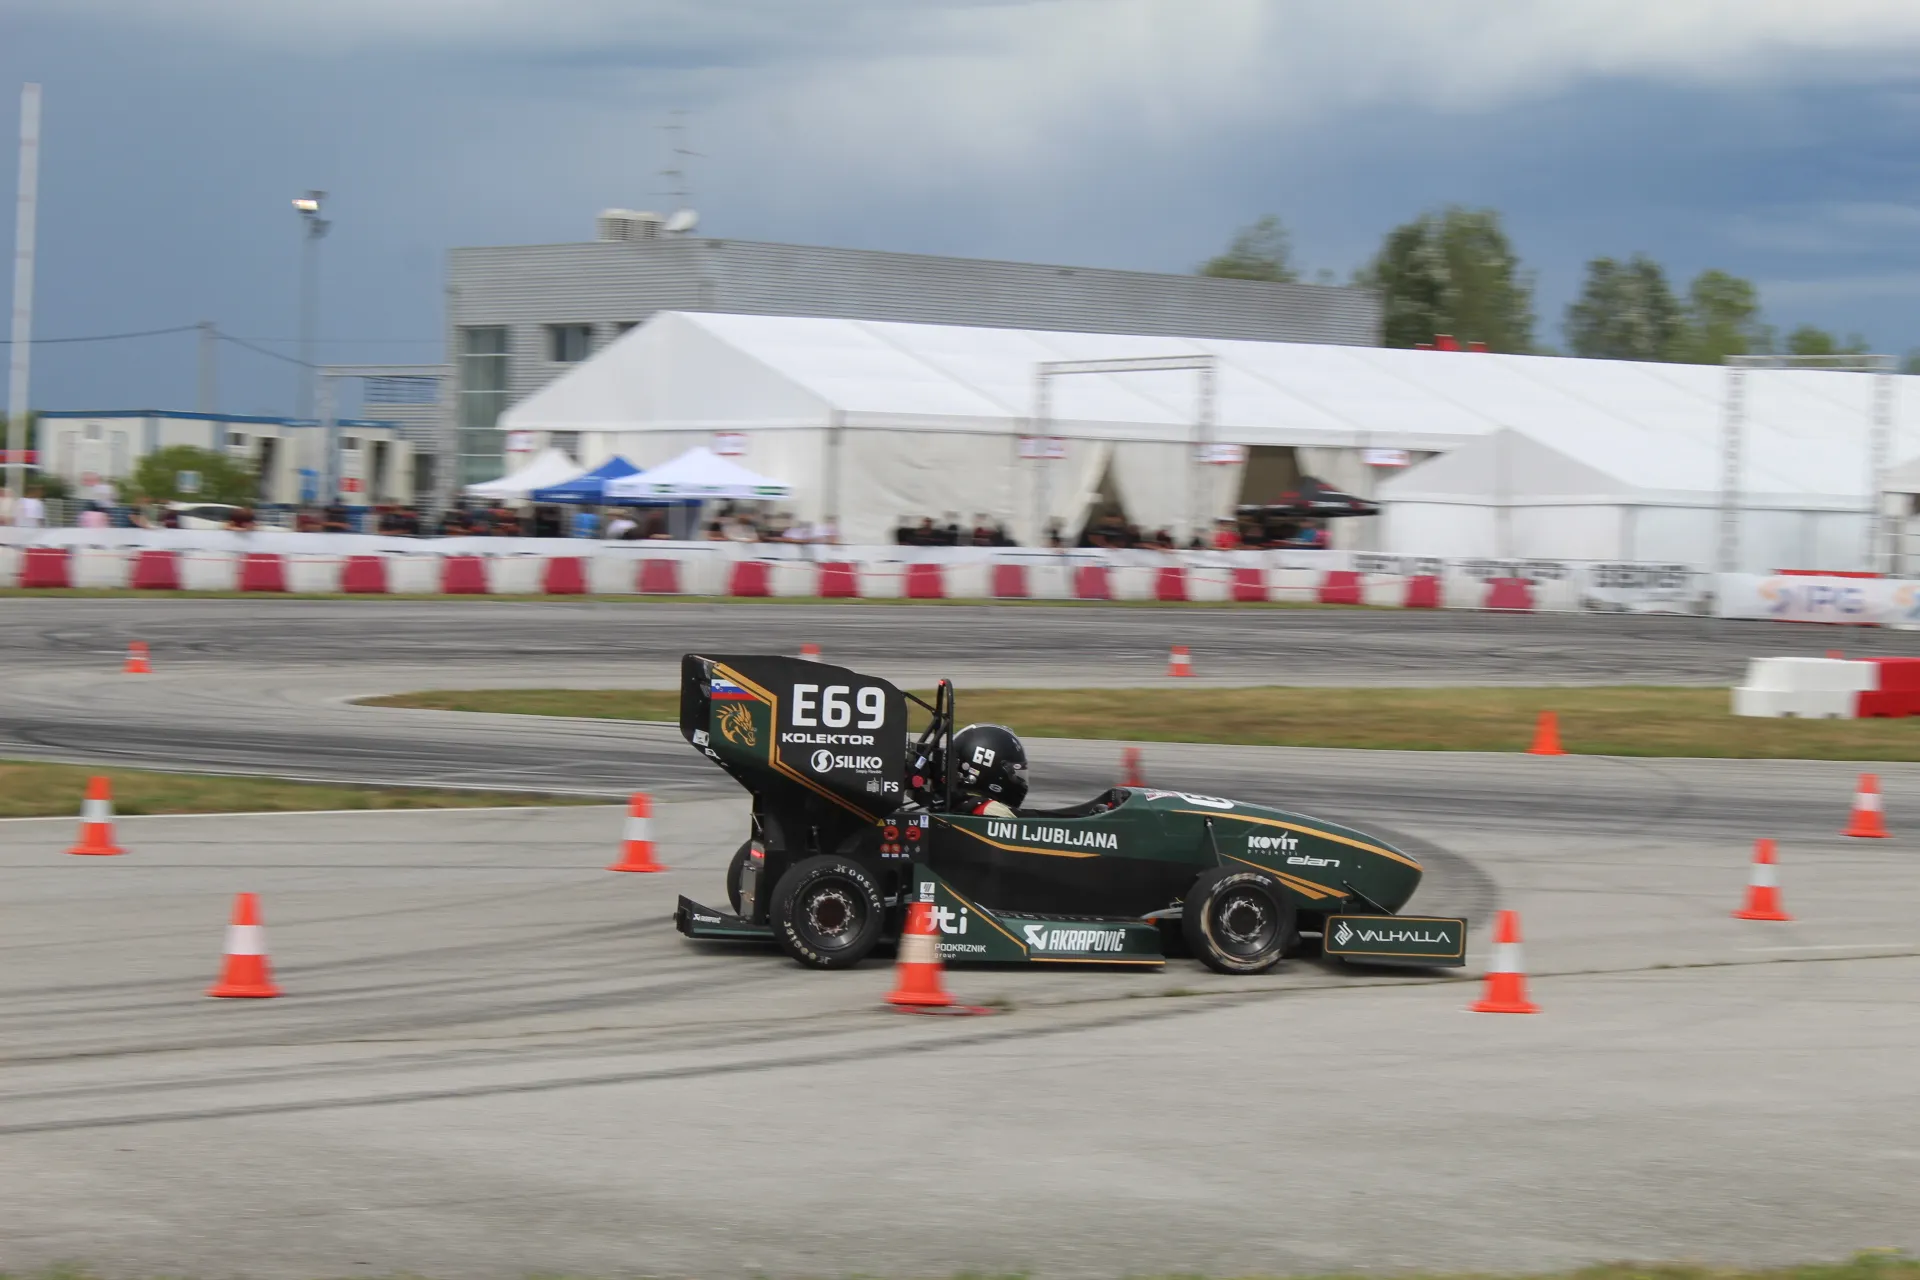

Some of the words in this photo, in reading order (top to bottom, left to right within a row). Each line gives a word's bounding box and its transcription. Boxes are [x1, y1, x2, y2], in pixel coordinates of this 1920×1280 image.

[792, 683, 885, 729] E69
[782, 733, 875, 745] KOLEKTOR
[834, 755, 883, 769] SILIKO
[972, 745, 996, 768] 69
[883, 781, 899, 792] FS
[987, 821, 1018, 840] UNI
[1021, 825, 1119, 850] LJUBLJANA
[1247, 832, 1299, 850] KOVIT
[1286, 855, 1340, 868] elan
[1356, 929, 1451, 943] VALHALLA
